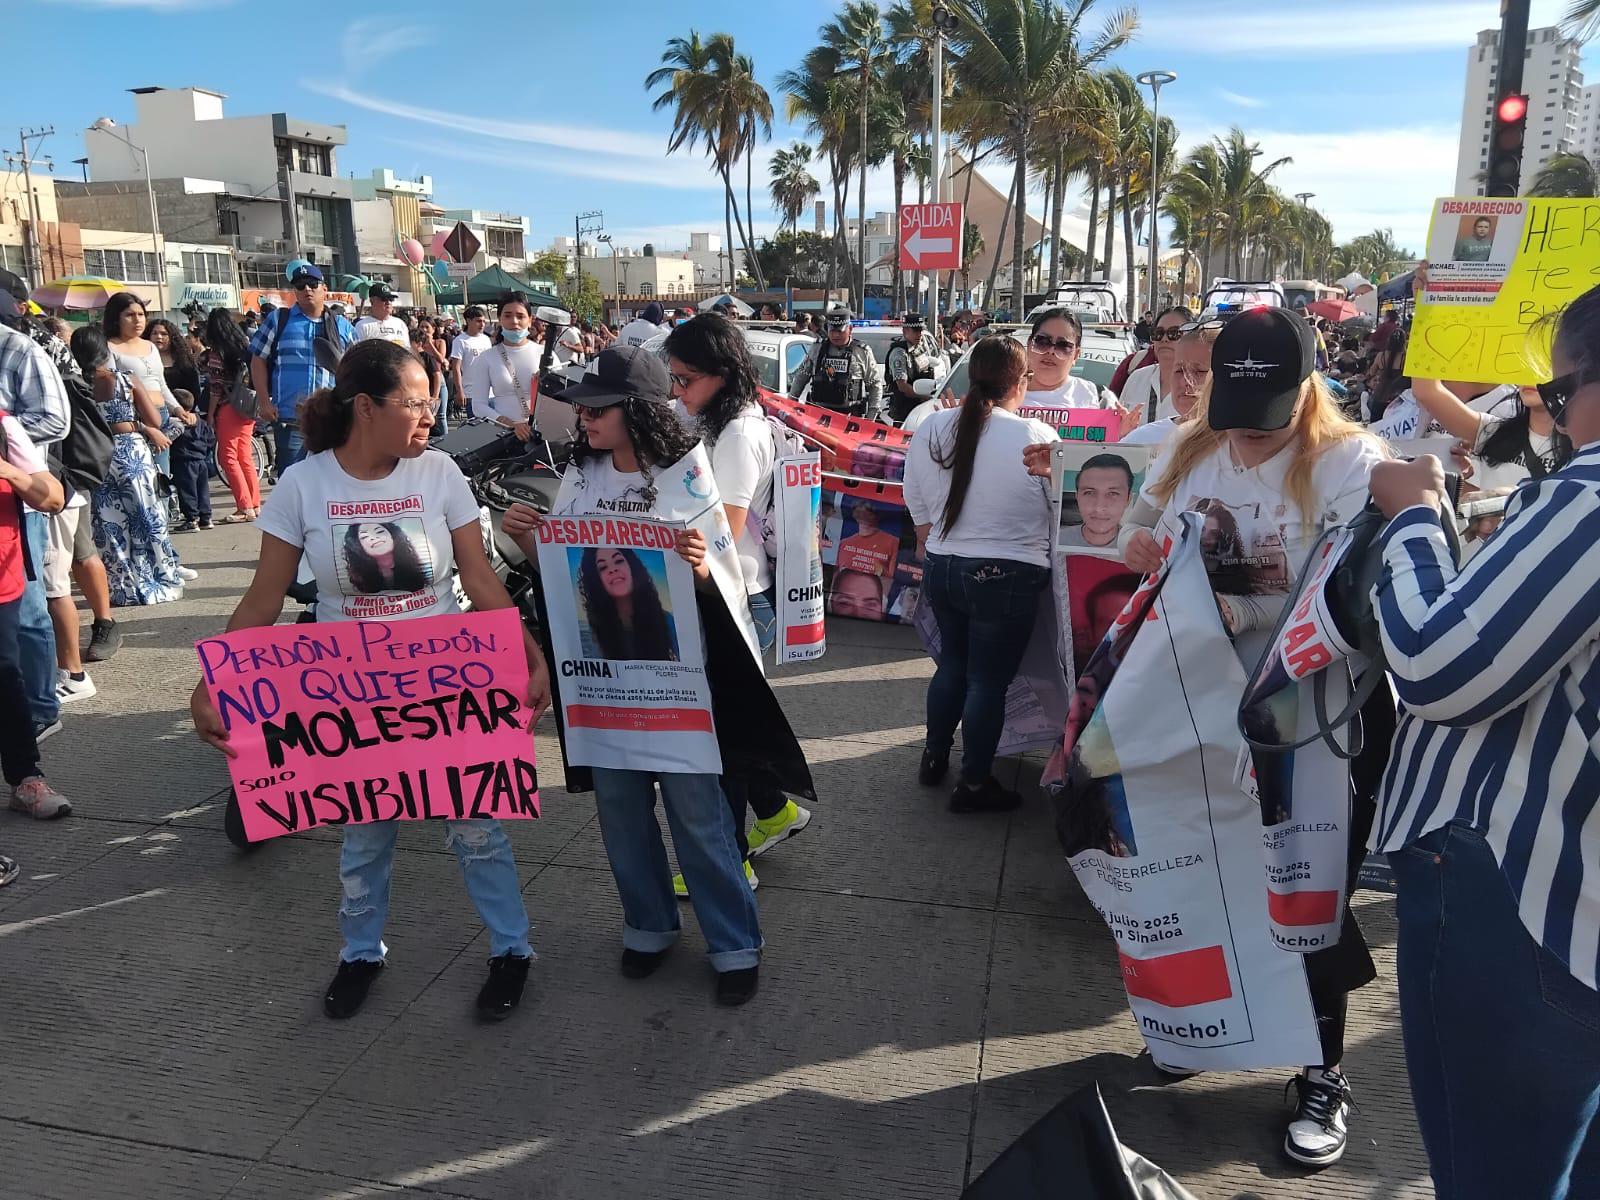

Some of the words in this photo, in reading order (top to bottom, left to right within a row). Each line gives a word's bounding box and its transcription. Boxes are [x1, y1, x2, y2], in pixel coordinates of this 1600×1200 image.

[902, 205, 954, 228] SALIDA
[1442, 201, 1523, 215] DESAPARECIDO
[331, 498, 420, 516] DESAPARECIDA
[405, 594, 436, 611] flores
[561, 659, 613, 679] CHINA
[216, 677, 281, 731] NO
[300, 661, 494, 705] QUIERO
[261, 688, 522, 769] MOLESTAR
[239, 770, 296, 793] SOLO
[255, 754, 540, 832] VISIBILIZAR
[1273, 823, 1339, 841] BERRELLEZA
[1114, 854, 1204, 880] BERRELLEZA
[1285, 861, 1311, 873] 2025
[1270, 872, 1311, 884] Sinaloa
[1108, 911, 1139, 928] julio
[1144, 912, 1180, 930] 2025
[1127, 927, 1183, 944] Sinaloa
[1142, 1014, 1228, 1040] mucho!
